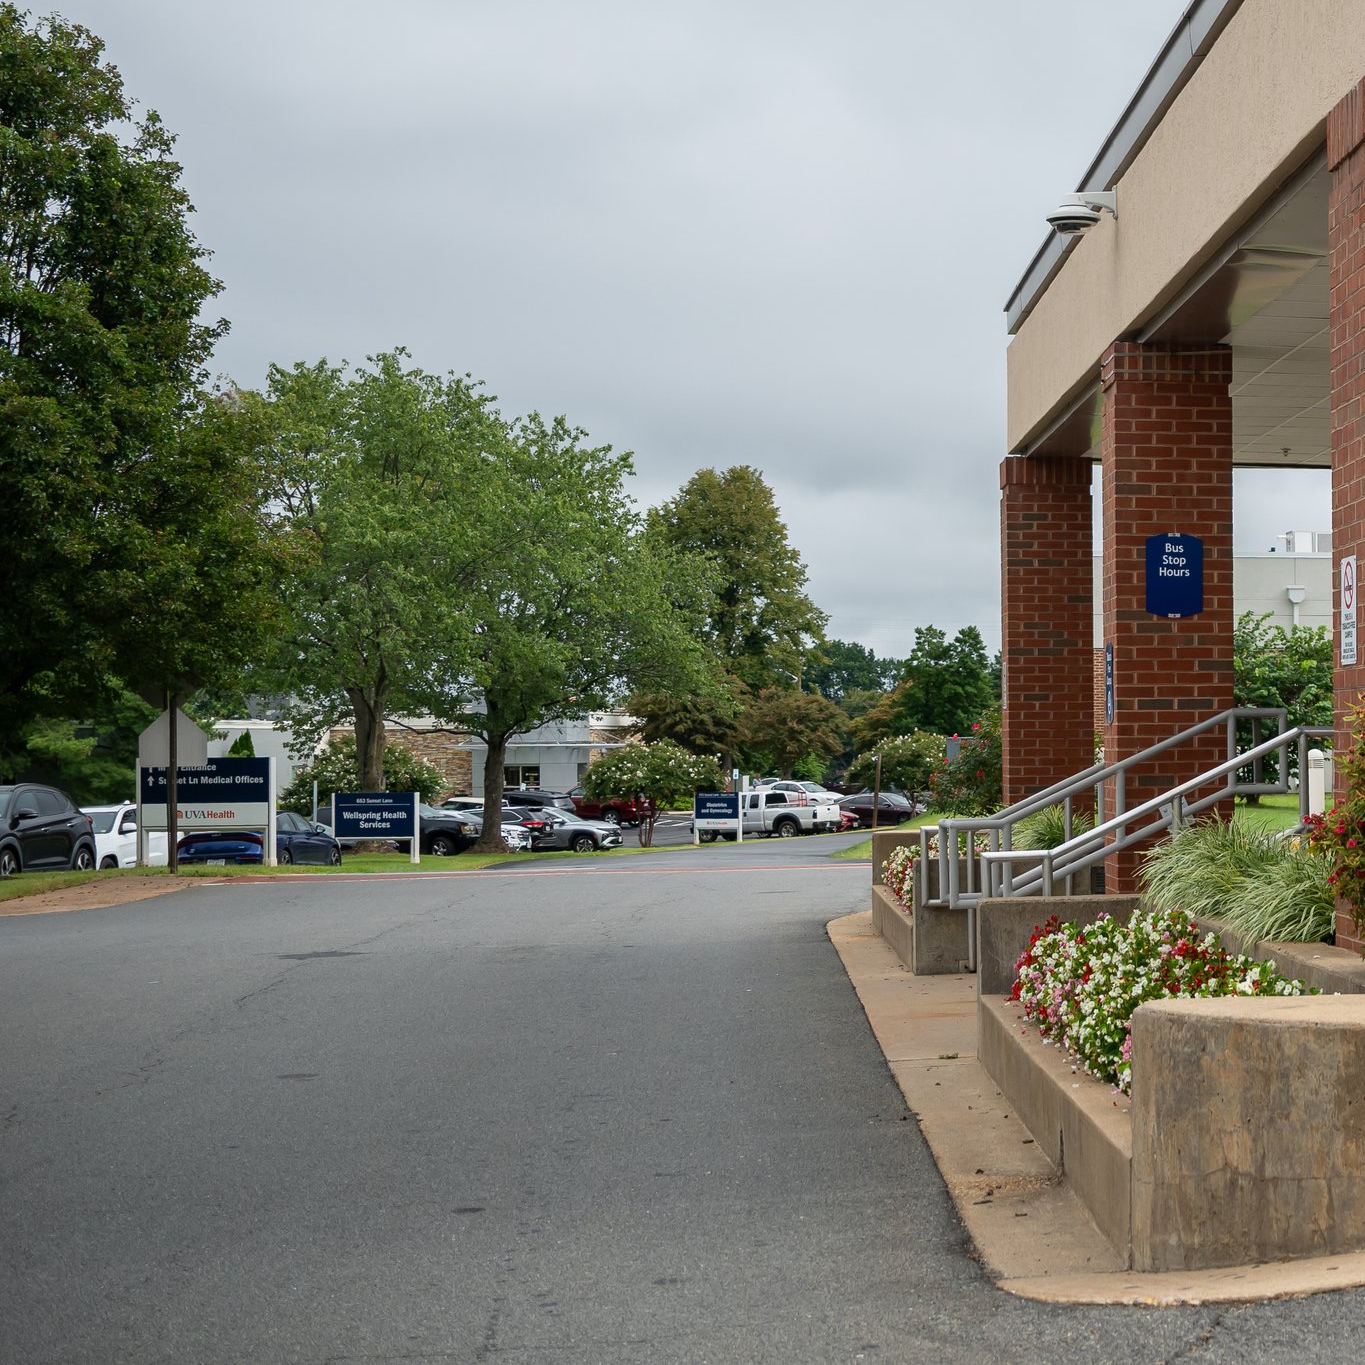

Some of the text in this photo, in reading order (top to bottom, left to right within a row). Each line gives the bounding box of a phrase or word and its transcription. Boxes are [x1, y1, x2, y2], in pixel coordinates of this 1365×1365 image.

[1165, 543, 1184, 553] Bus
[1162, 555, 1187, 567] Stop
[1159, 567, 1191, 577] Hours
[188, 776, 199, 784] Ln
[200, 775, 233, 784] Medical
[234, 775, 264, 784] Offices
[342, 811, 407, 820] Wellspring Health
[359, 820, 391, 829] Services
